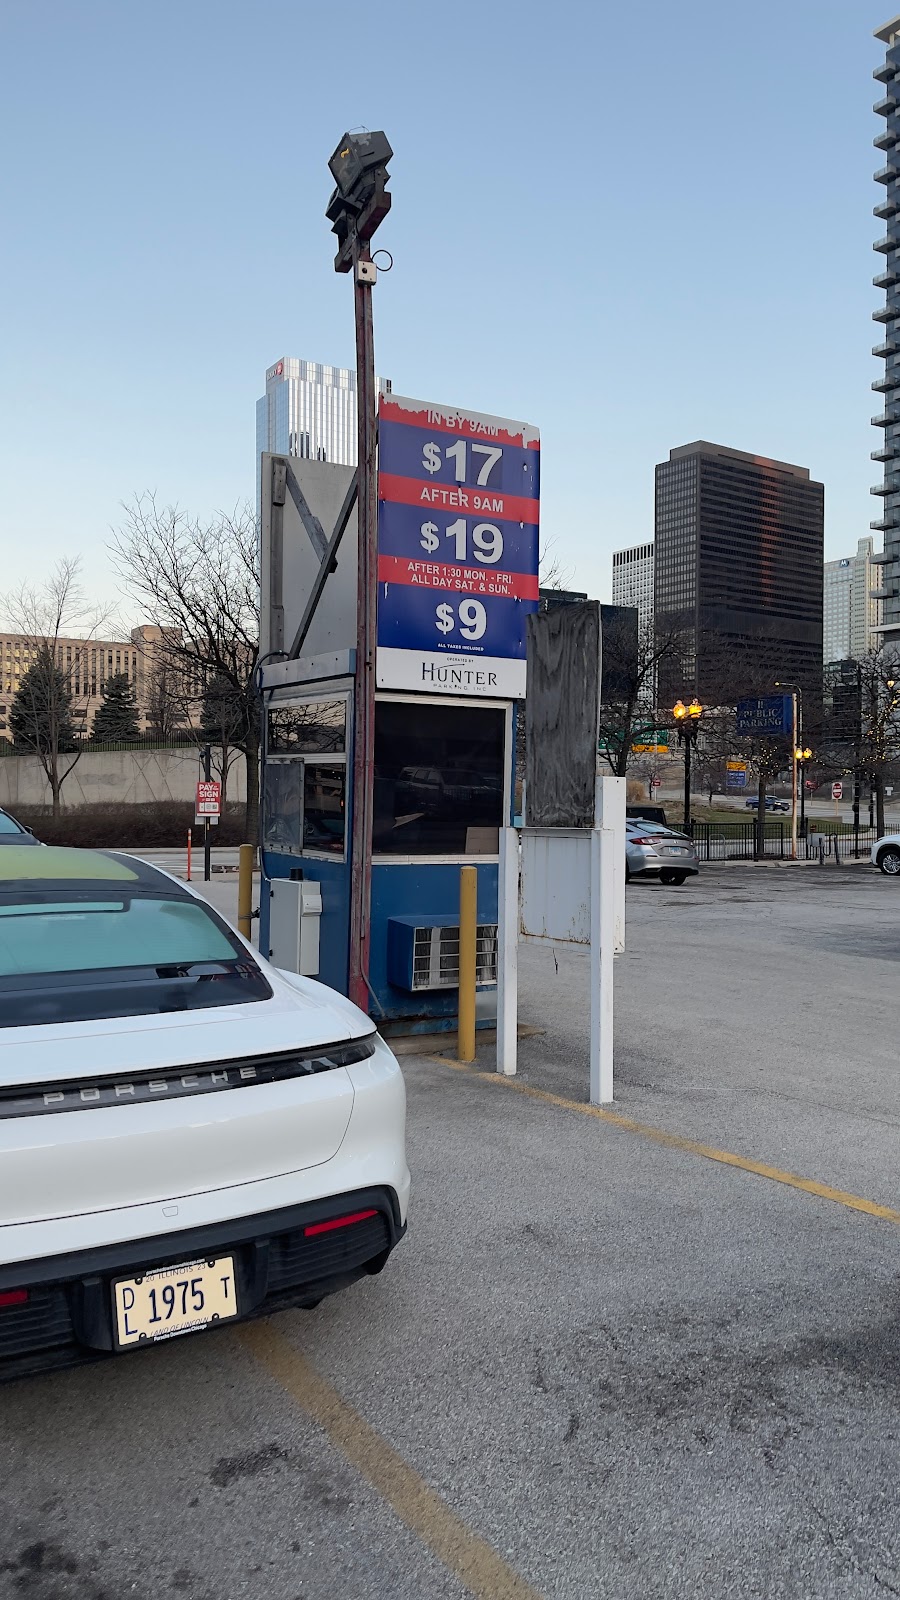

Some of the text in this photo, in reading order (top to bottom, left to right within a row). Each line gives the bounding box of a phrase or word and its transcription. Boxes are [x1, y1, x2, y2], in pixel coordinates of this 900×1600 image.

[427, 410, 499, 437] IN BY 9AM
[421, 440, 503, 487] $17
[420, 487, 504, 513] AFTER 9AM
[420, 518, 504, 564] $19
[407, 561, 440, 575] AFTER
[442, 566, 461, 578] 1:30
[463, 569, 488, 581] MON.
[496, 573, 514, 584] FRI.
[411, 573, 511, 595] ALL DAY SAT. & SUN.
[435, 598, 487, 641] $9
[421, 662, 498, 686] HUNTER
[740, 718, 782, 728] PARKING
[42, 1066, 257, 1106] PORSCHE
[148, 1277, 205, 1324] 1975
[220, 1276, 230, 1299] T
